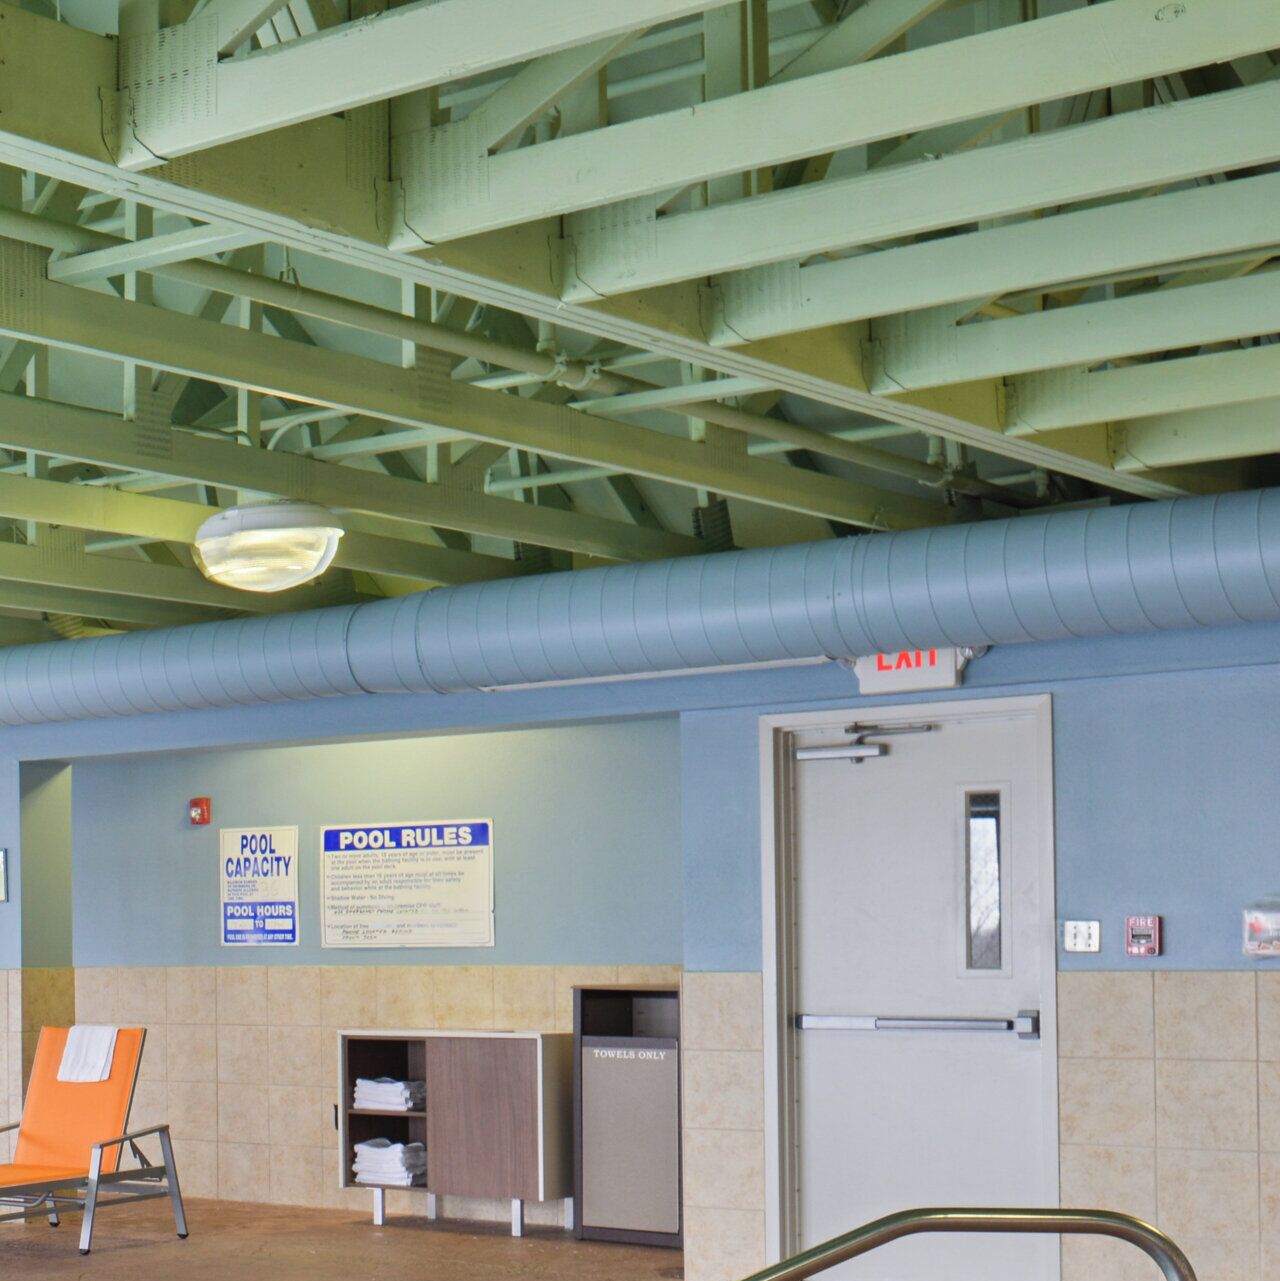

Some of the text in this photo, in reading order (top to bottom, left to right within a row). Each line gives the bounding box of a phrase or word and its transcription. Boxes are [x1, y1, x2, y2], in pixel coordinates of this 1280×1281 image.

[340, 826, 472, 850] POOL RULES
[241, 834, 276, 855] POOL
[226, 856, 291, 878] CAPACITY
[227, 905, 292, 916] POOL HOURS
[255, 920, 264, 928] TO
[1130, 918, 1153, 927] FIRE
[594, 1049, 666, 1060] TOWELS ONLY
